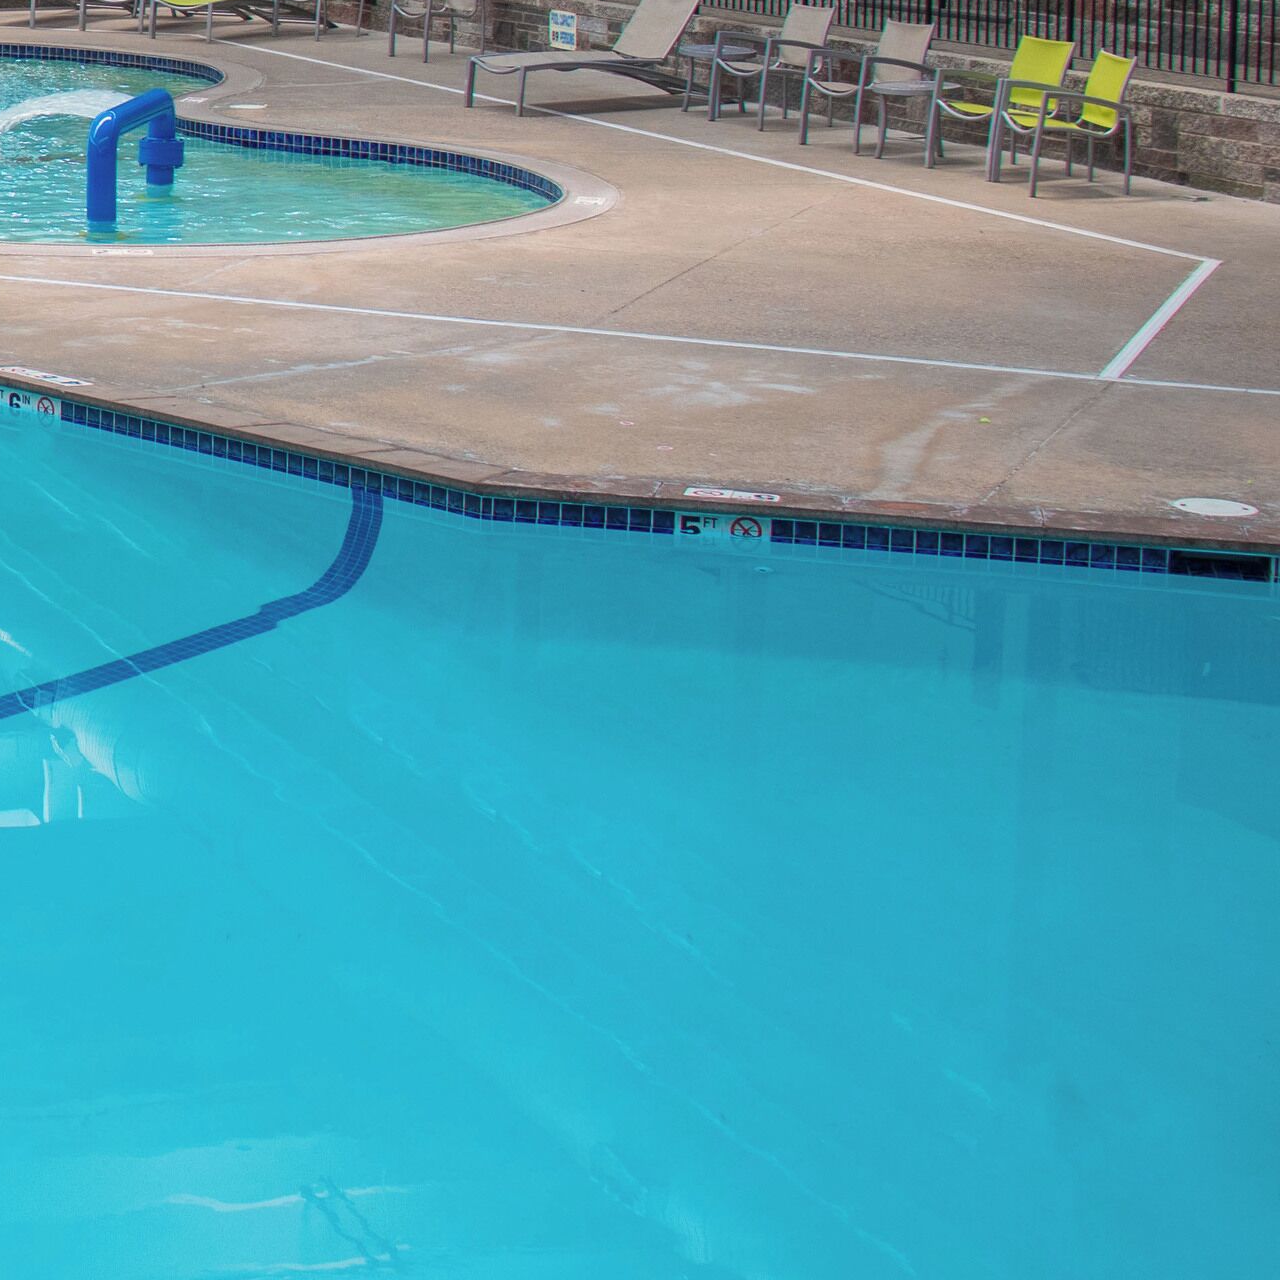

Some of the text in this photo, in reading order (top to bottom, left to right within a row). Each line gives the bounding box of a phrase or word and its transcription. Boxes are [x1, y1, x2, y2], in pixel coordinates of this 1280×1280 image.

[8, 392, 21, 408] 6
[22, 394, 31, 405] IN
[680, 515, 718, 535] 5 FT
